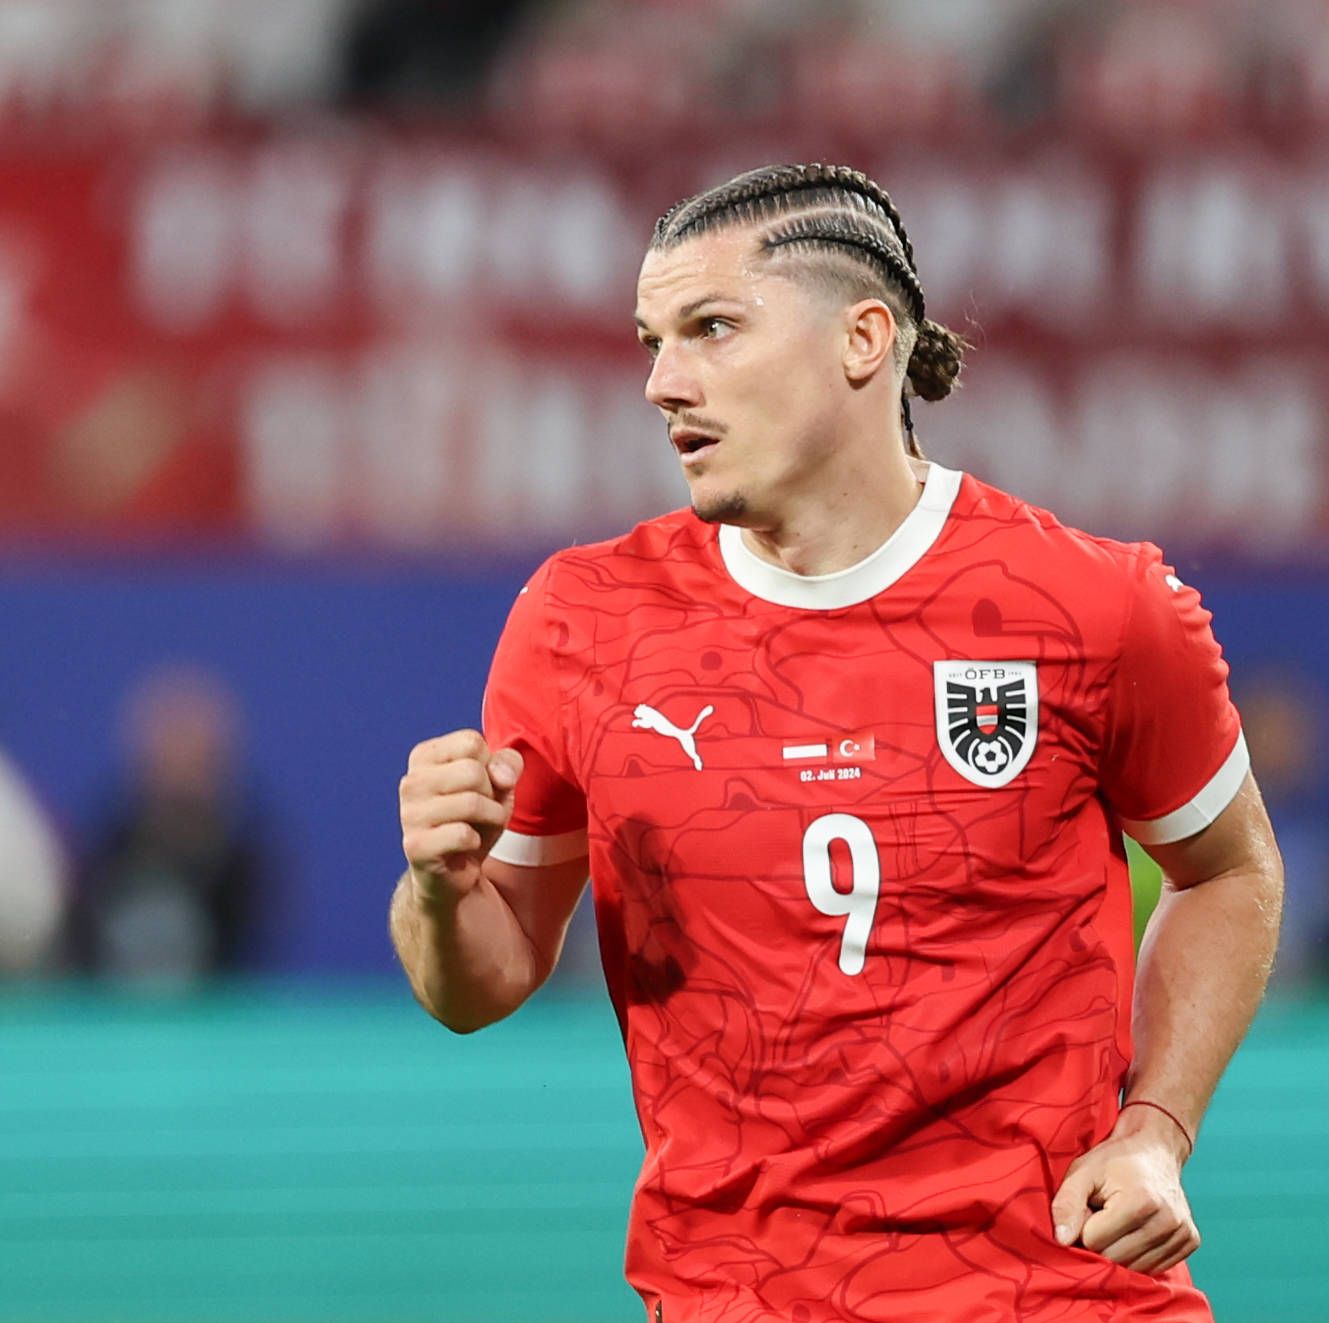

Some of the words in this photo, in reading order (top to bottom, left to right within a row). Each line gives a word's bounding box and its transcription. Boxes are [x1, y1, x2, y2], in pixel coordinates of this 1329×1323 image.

[965, 667, 1005, 680] ÖFB
[800, 770, 816, 782] 02.
[837, 767, 861, 780] 2024
[802, 813, 880, 976] 9
